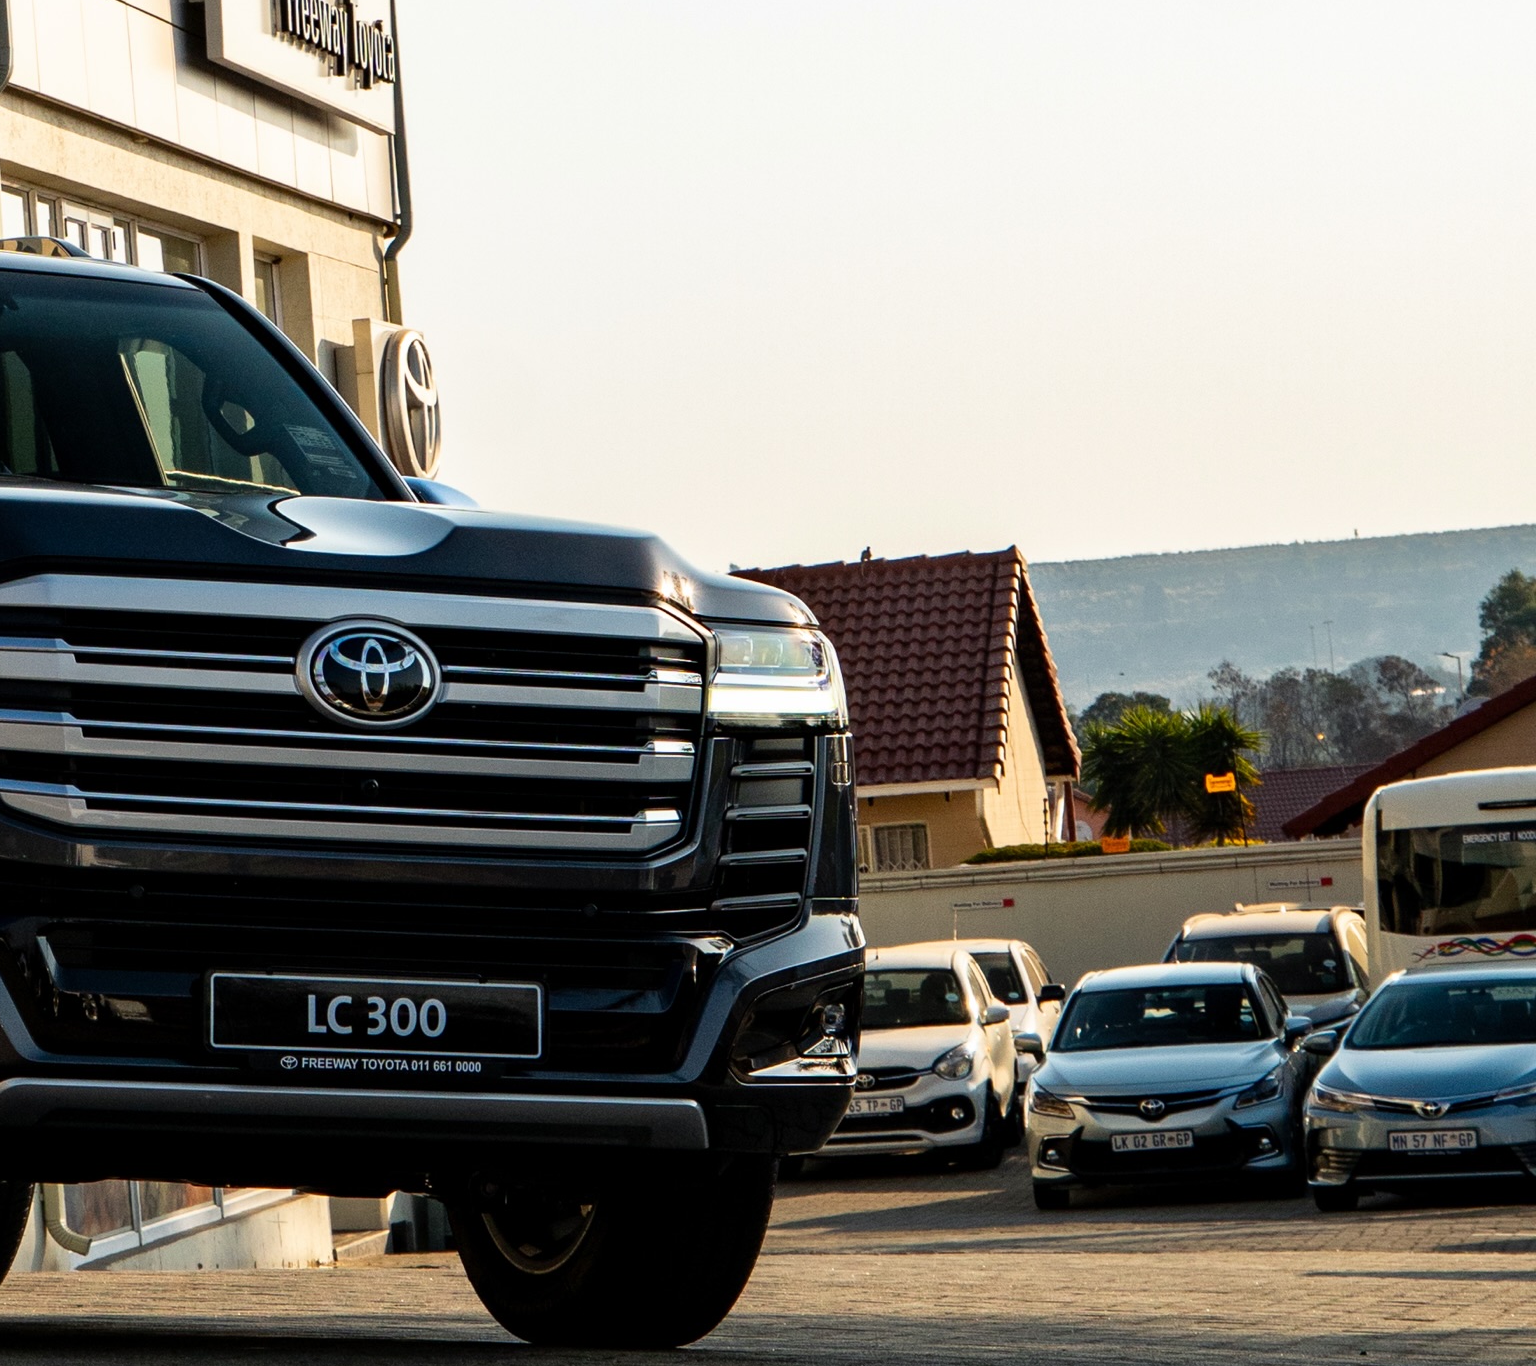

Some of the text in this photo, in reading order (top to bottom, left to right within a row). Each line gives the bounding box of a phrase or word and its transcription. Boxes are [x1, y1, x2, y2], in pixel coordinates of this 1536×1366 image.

[307, 994, 447, 1037] LC 300
[301, 1056, 482, 1073] FREEWAY TOYOTA 011 661 0000
[848, 1098, 903, 1113] 65 TP GP
[1113, 1133, 1190, 1150] LK 02 GR GP
[1391, 1132, 1473, 1149] MN 57 NF GP
